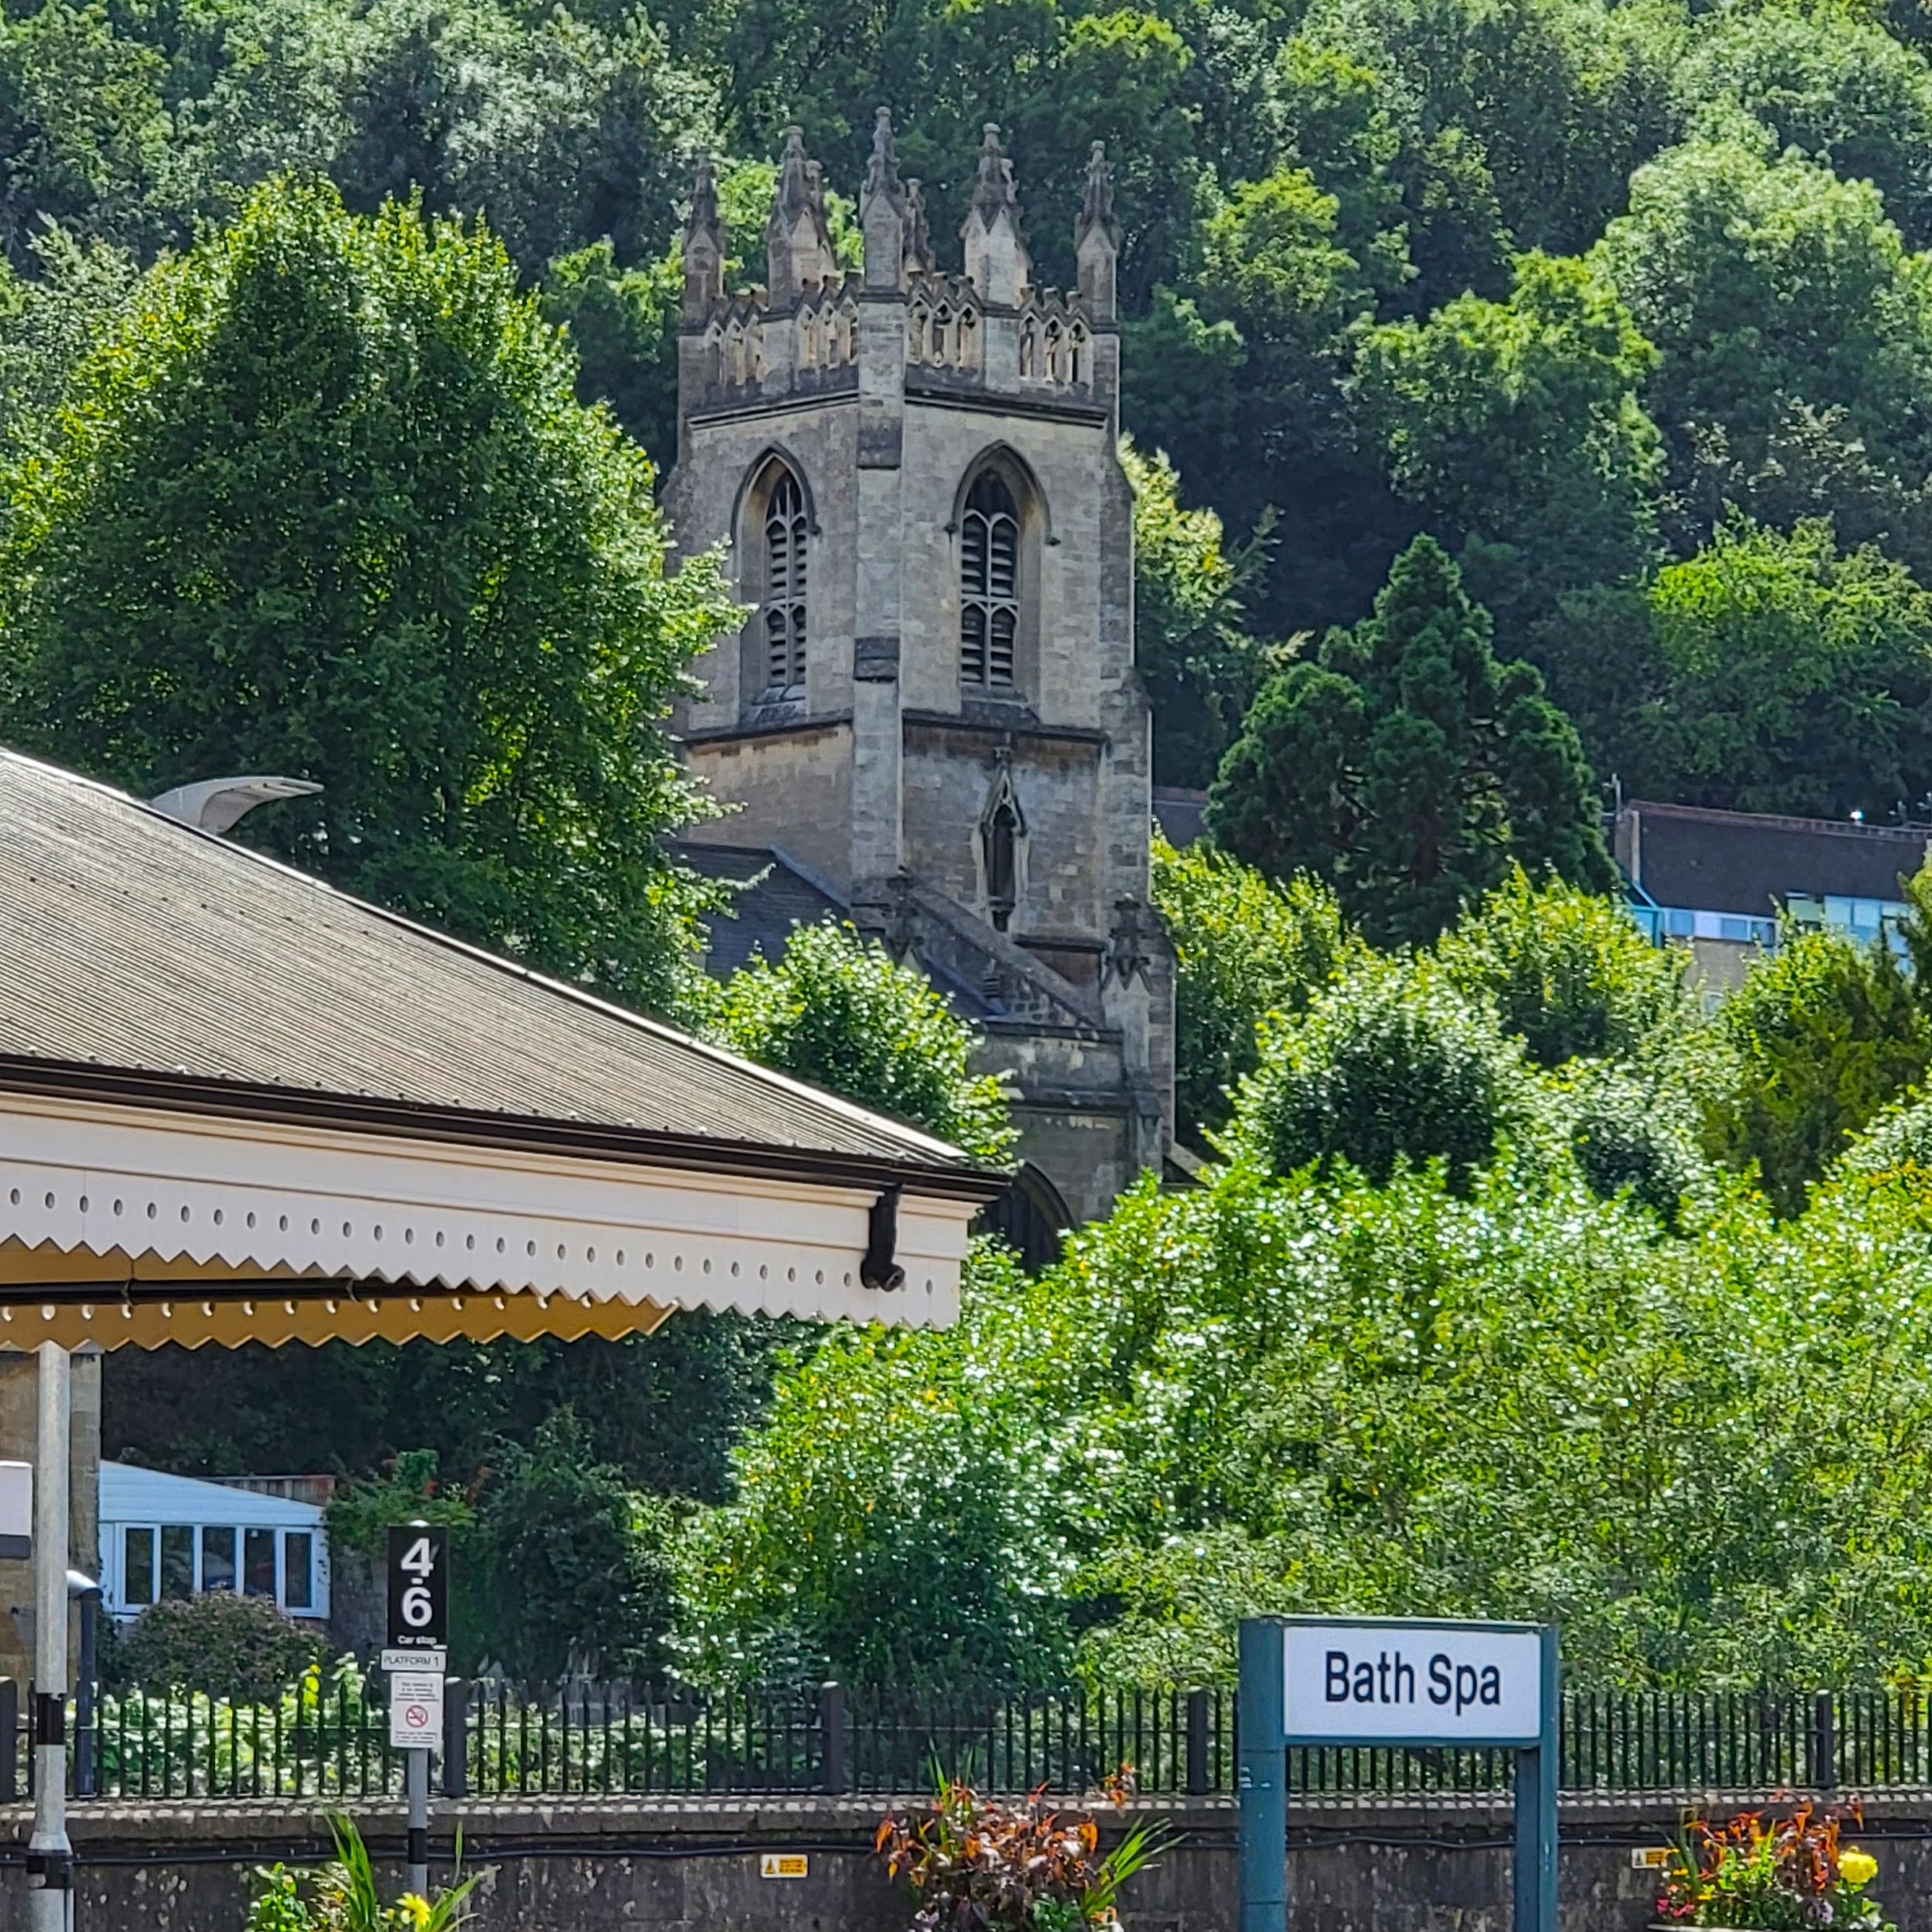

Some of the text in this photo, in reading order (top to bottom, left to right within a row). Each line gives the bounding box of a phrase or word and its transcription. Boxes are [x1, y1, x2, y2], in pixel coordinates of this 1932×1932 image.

[400, 1537, 434, 1577] 4
[402, 1586, 433, 1627] 6
[384, 1655, 439, 1666] PLATFORM 1
[398, 1634, 437, 1648] Car stop
[1325, 1650, 1501, 1716] Bath Spa
